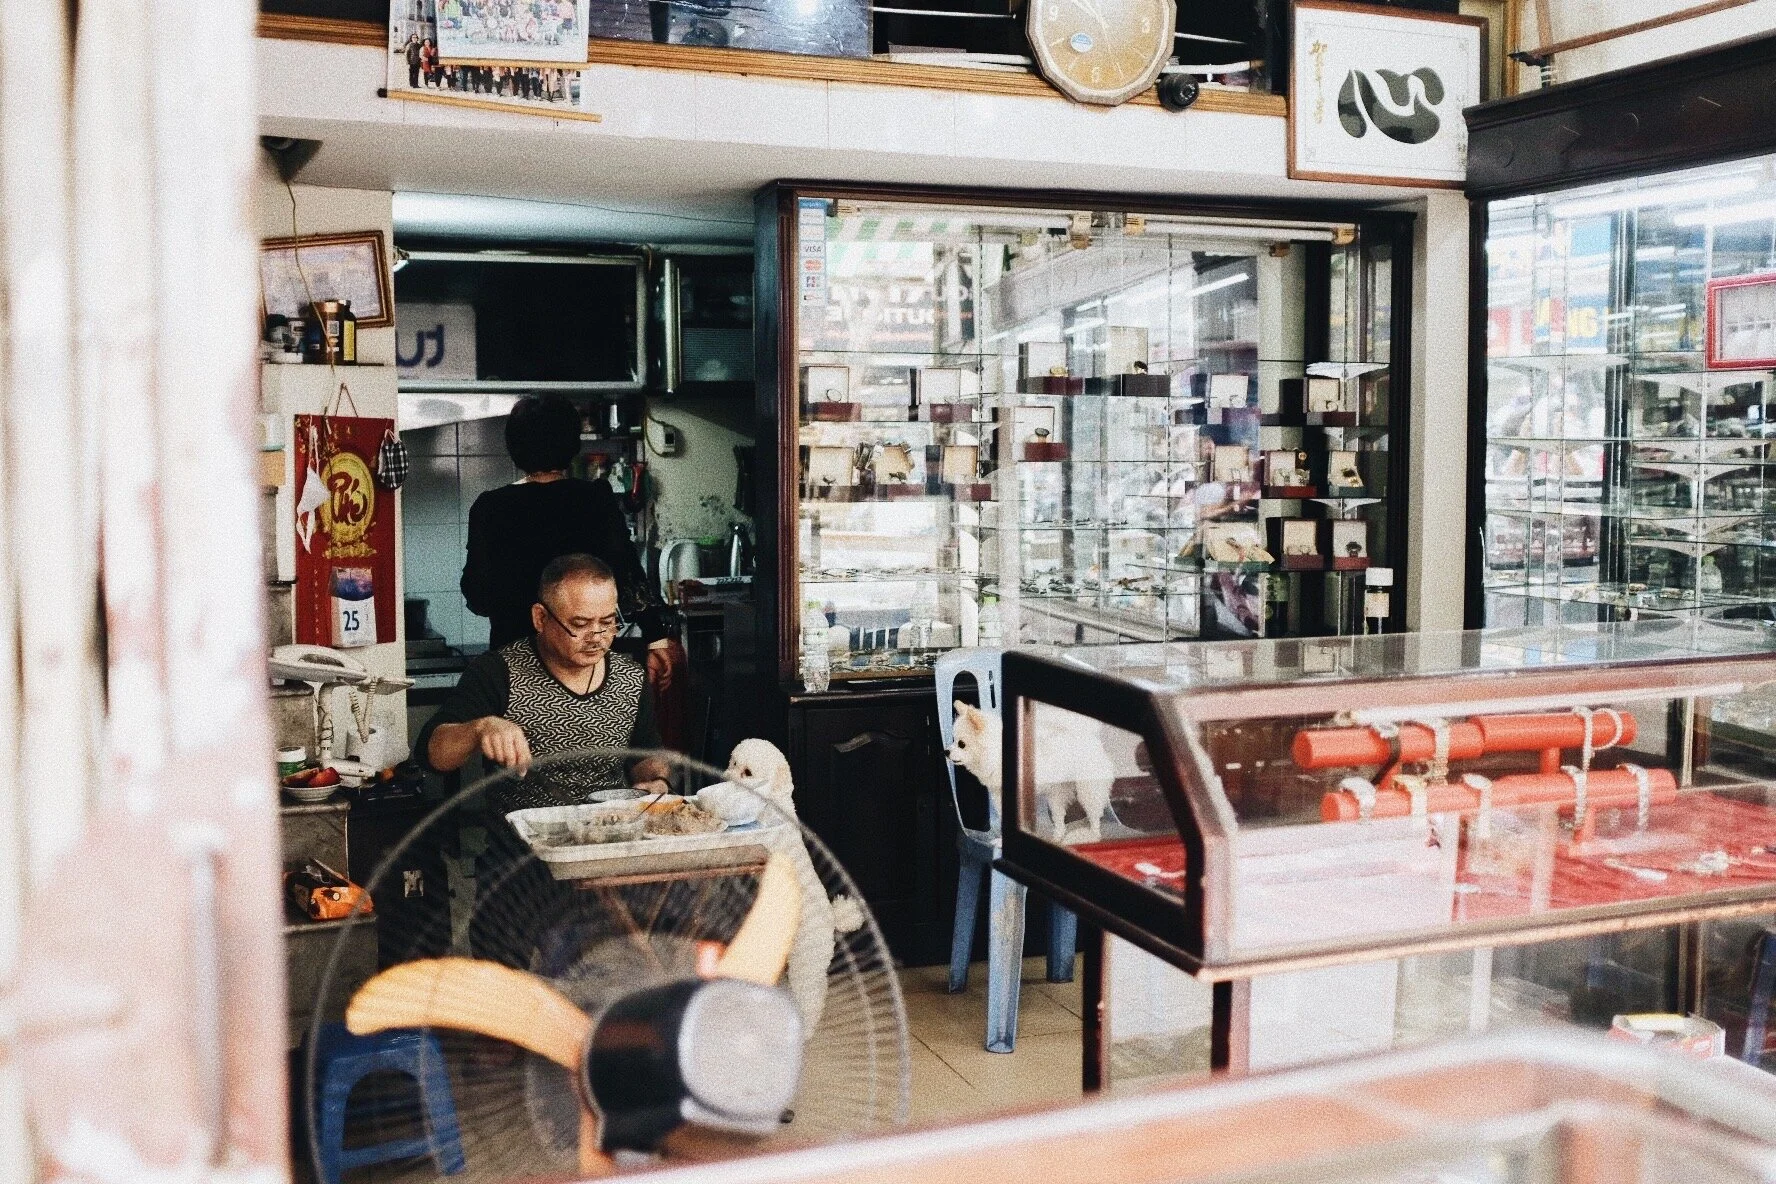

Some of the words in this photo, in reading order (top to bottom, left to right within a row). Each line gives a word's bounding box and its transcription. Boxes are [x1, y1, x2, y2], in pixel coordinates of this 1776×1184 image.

[1049, 5, 1059, 21] 9
[1141, 17, 1150, 33] 3
[804, 245, 822, 253] VISA
[342, 610, 361, 632] 25
